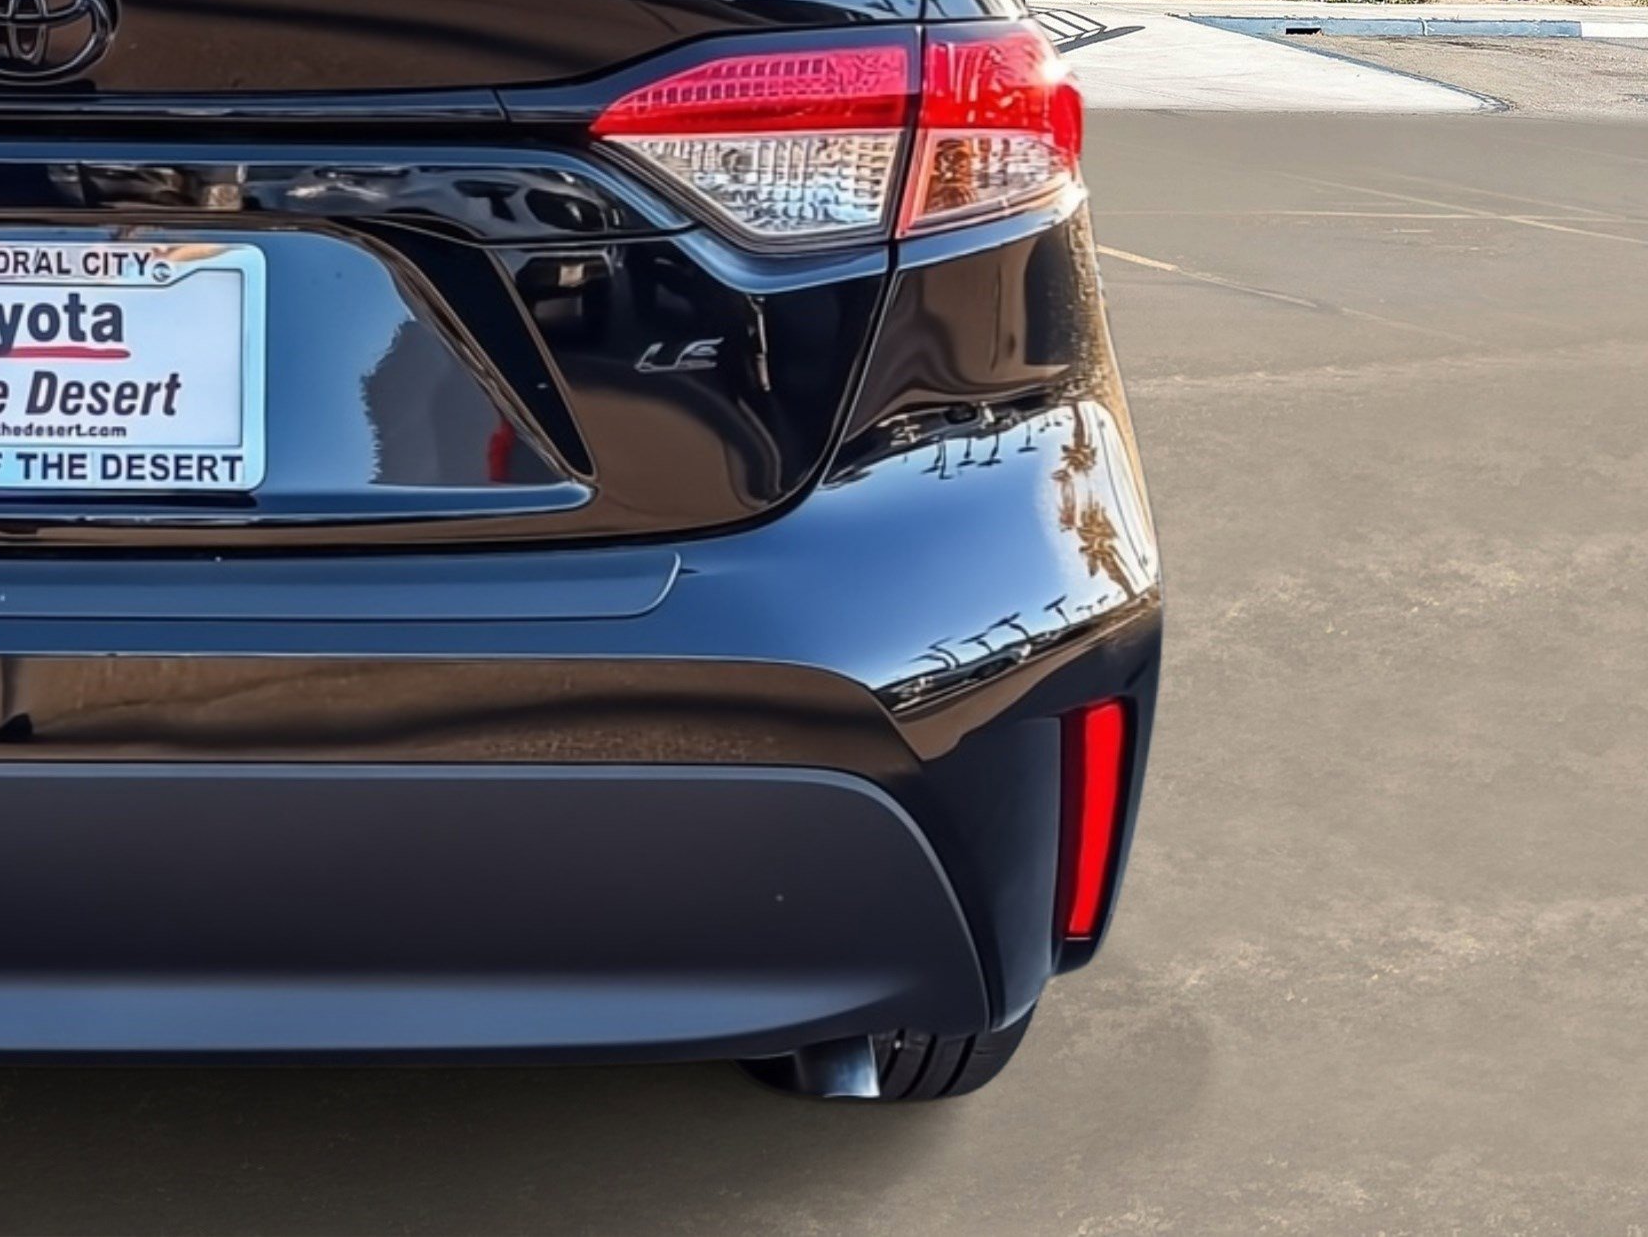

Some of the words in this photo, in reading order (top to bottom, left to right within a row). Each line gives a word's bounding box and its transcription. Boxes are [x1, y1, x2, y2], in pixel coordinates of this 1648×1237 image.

[82, 250, 151, 277] CITY
[633, 337, 724, 373] LE
[25, 373, 181, 417] Desert
[16, 453, 88, 481] THE
[100, 454, 244, 482] DESERT
